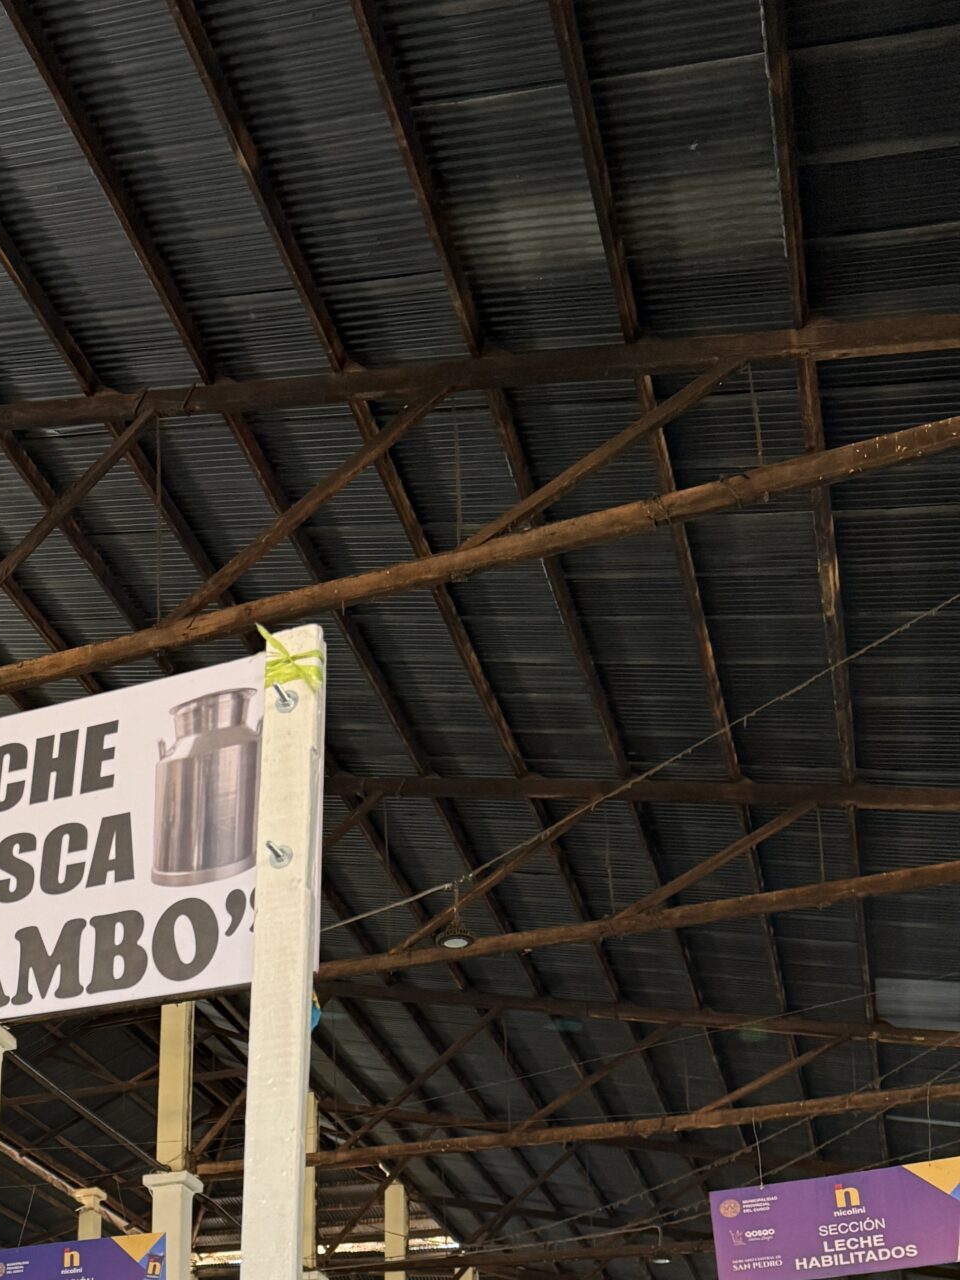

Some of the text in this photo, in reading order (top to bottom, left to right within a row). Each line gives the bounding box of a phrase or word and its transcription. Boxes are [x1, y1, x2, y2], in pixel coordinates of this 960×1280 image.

[833, 1206, 866, 1217] nicolini
[818, 1218, 886, 1237] SECCIÓN
[823, 1234, 885, 1253] LECHE
[732, 1260, 783, 1271] SAN PEDRO
[795, 1244, 918, 1270] HABILITADOS
